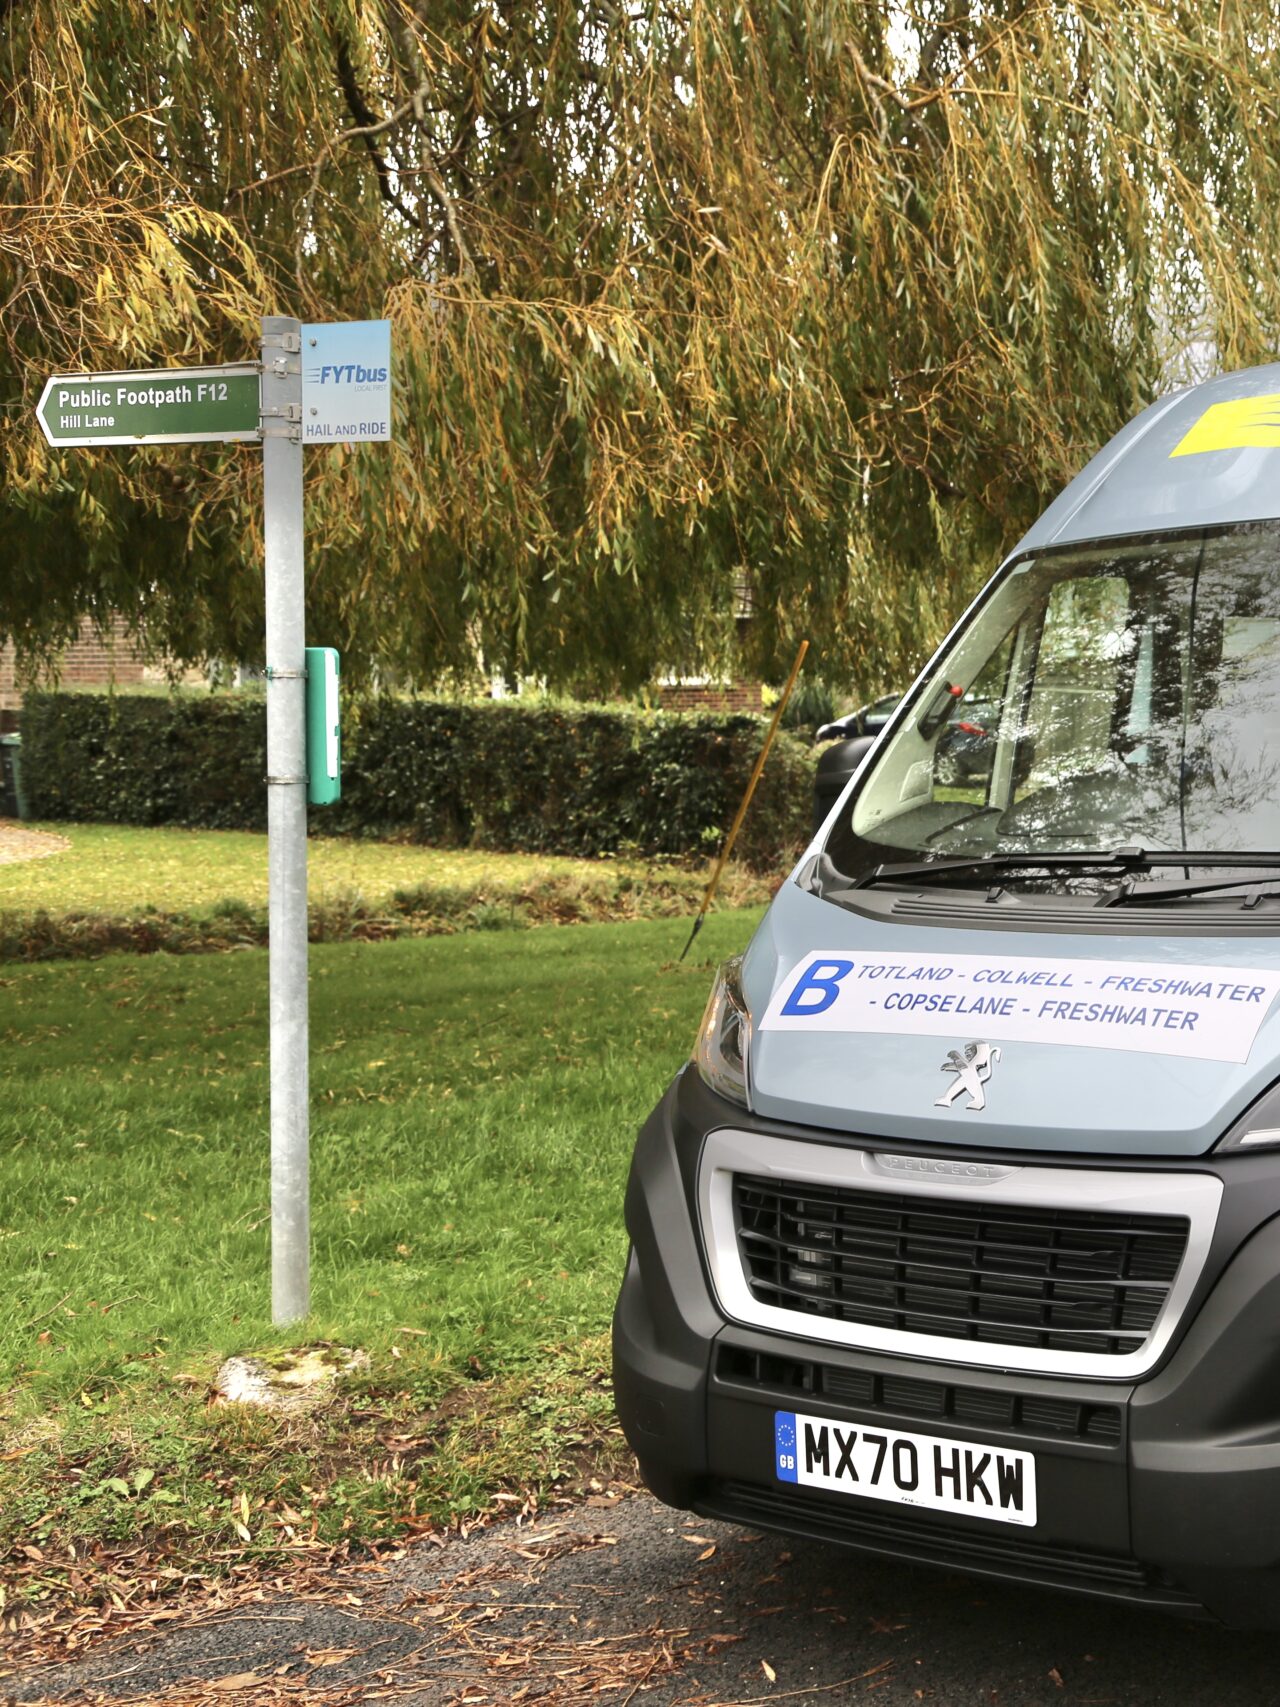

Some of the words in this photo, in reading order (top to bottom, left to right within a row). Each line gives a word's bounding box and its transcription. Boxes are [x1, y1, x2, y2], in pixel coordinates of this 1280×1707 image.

[320, 364, 388, 384] FYTbus
[59, 390, 111, 408] Public
[117, 385, 192, 408] Footpath
[197, 383, 228, 402] F12
[60, 415, 81, 428] Hill
[85, 415, 115, 427] Lane
[306, 423, 333, 437] HAIL
[335, 424, 358, 436] AND
[360, 421, 387, 435] RIDE
[780, 959, 854, 1016] B
[857, 965, 955, 981] TOTLAND
[972, 969, 1075, 987] COLWELL
[1099, 975, 1266, 1003] FRESHWATER
[1037, 1000, 1199, 1031] FRESHWATER
[889, 1158, 994, 1177] PEUGEOT
[780, 1455, 795, 1470] GB
[804, 1422, 919, 1492] MX70
[933, 1444, 1023, 1512] HKW
